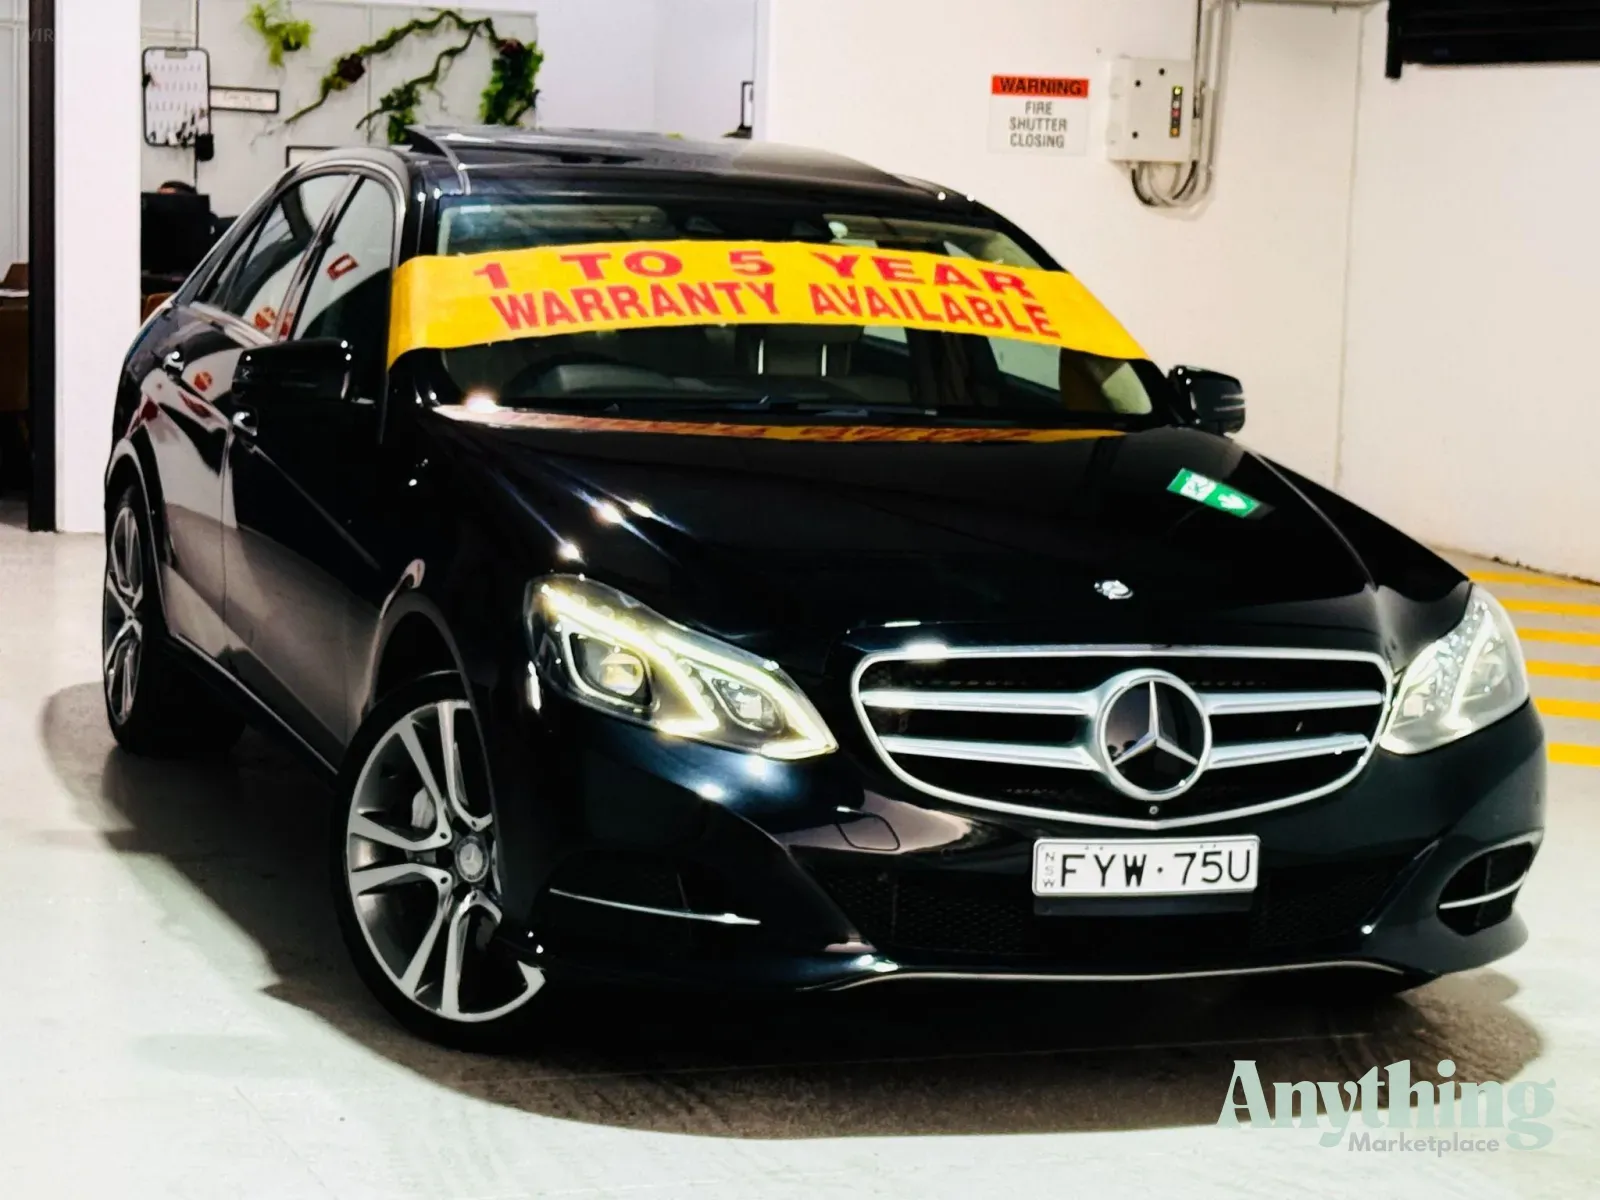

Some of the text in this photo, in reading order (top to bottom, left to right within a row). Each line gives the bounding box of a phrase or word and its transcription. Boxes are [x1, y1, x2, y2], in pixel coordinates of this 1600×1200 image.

[1000, 77, 1082, 95] WARNING
[1025, 101, 1053, 116] FIRE
[1009, 117, 1067, 132] SHUTTER
[1010, 133, 1064, 149] CLOSING
[473, 250, 1036, 300] 1 TO 5 YEAR
[490, 281, 1061, 338] WARRANTY AVAILABLE
